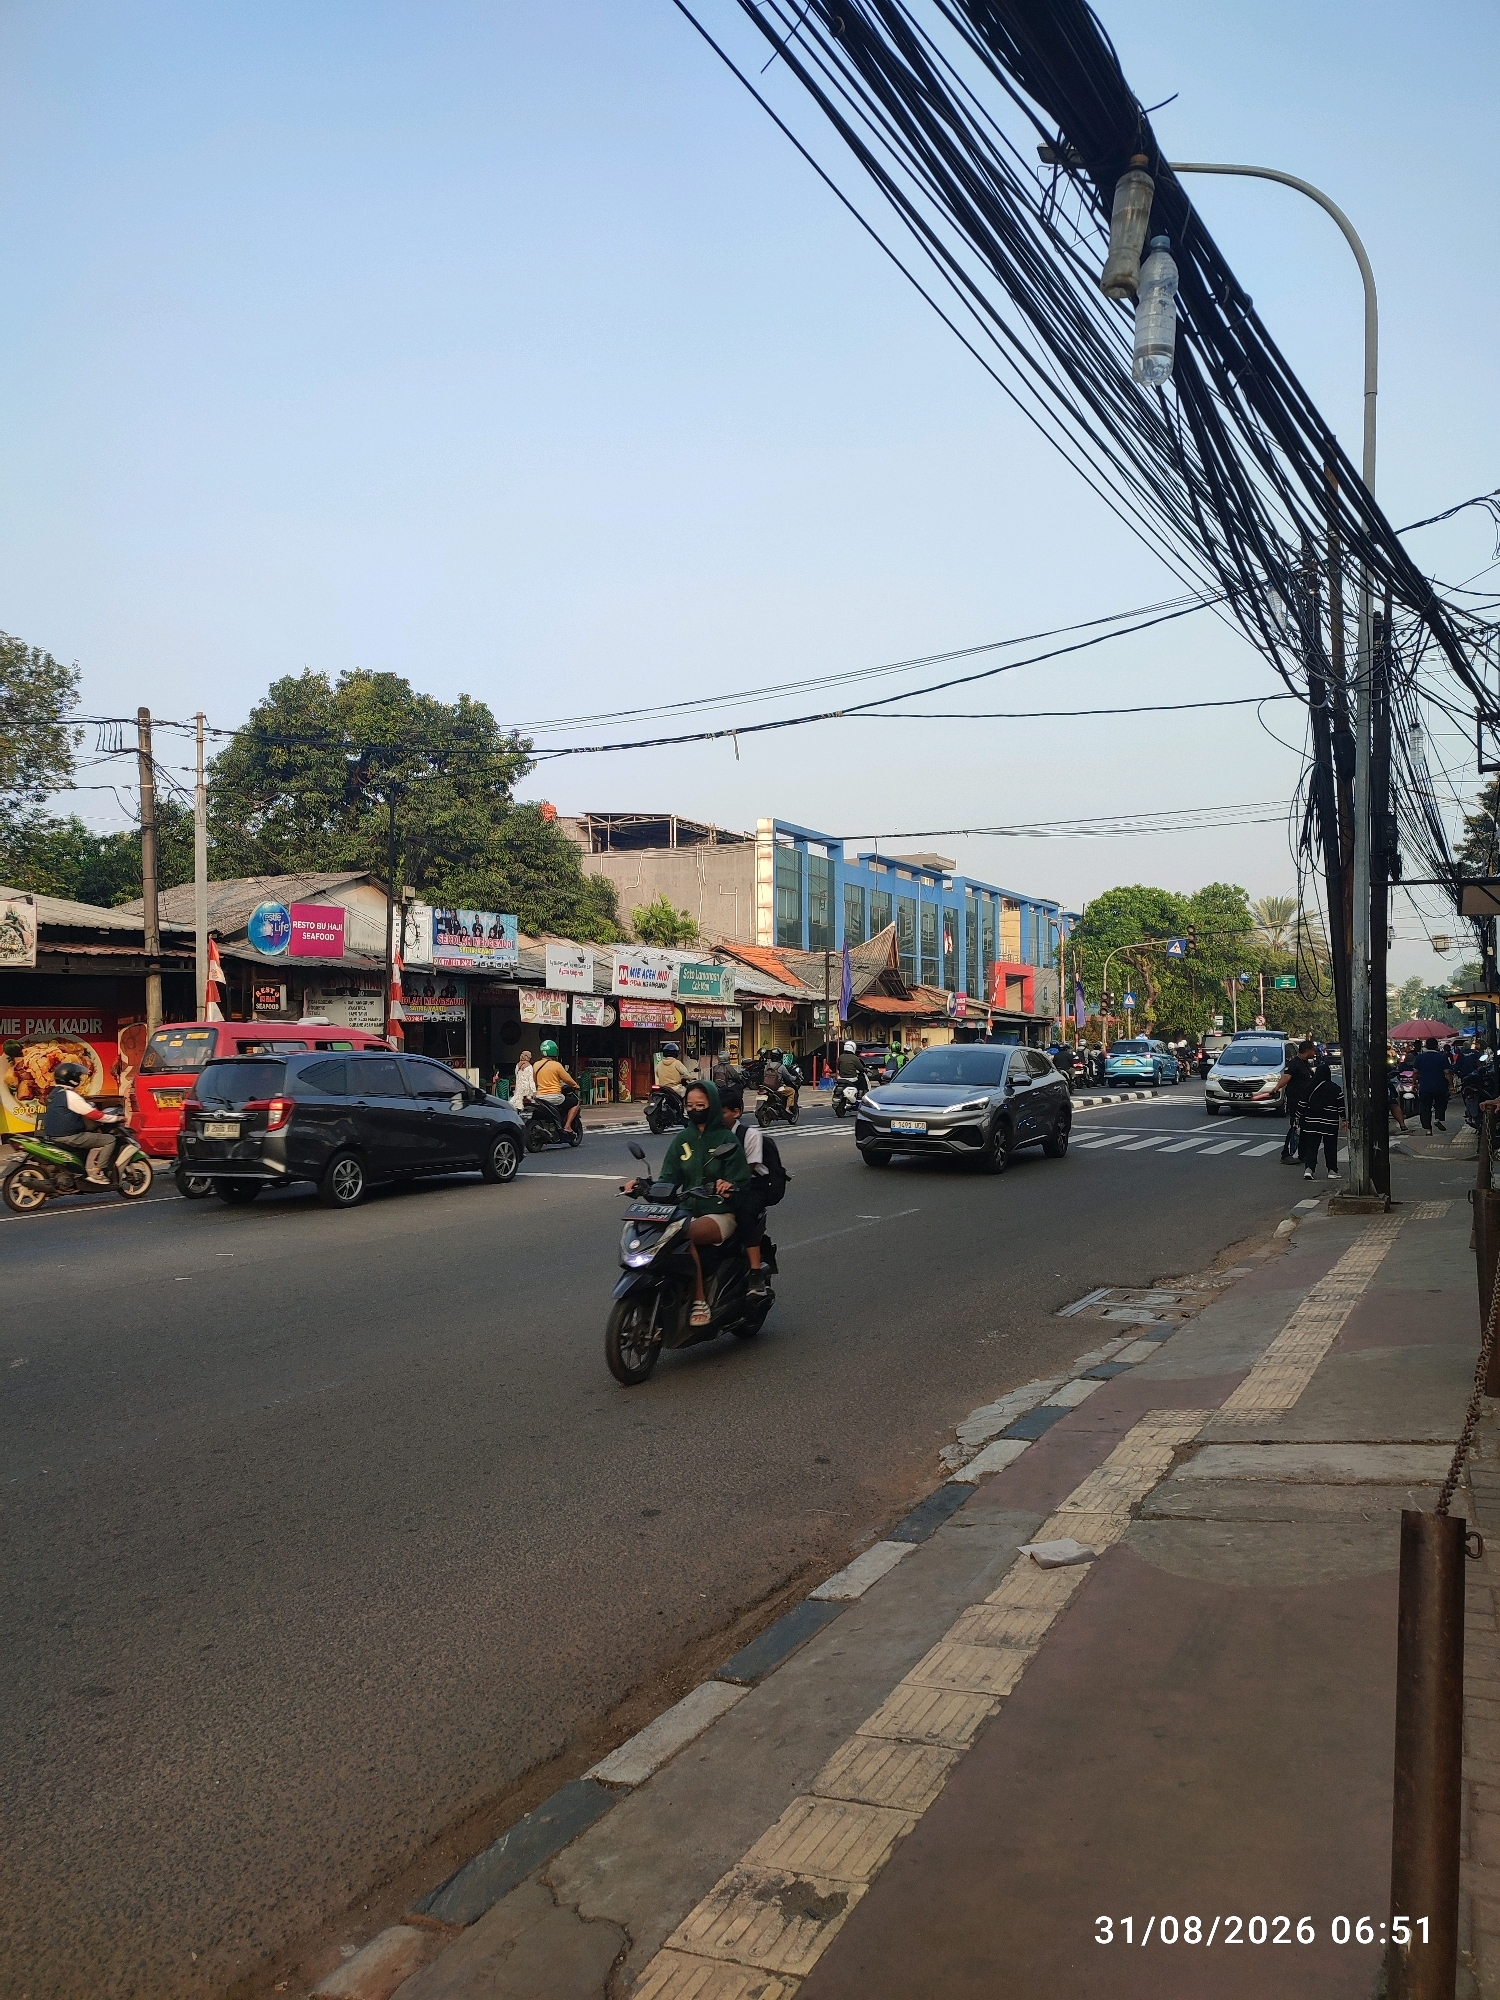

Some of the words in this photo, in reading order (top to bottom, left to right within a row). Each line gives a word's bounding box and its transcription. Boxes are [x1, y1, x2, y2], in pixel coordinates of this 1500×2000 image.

[292, 921, 315, 930] RESTO
[316, 921, 326, 930] BU
[327, 923, 343, 932] HAJI
[302, 932, 335, 941] SEAFOOD
[437, 934, 472, 946] SEKOLAH
[473, 936, 514, 949] MENGEMUDI
[629, 967, 641, 979] MIE
[683, 968, 695, 979] Soto
[255, 986, 280, 998] RESTO
[680, 1142, 693, 1161] J
